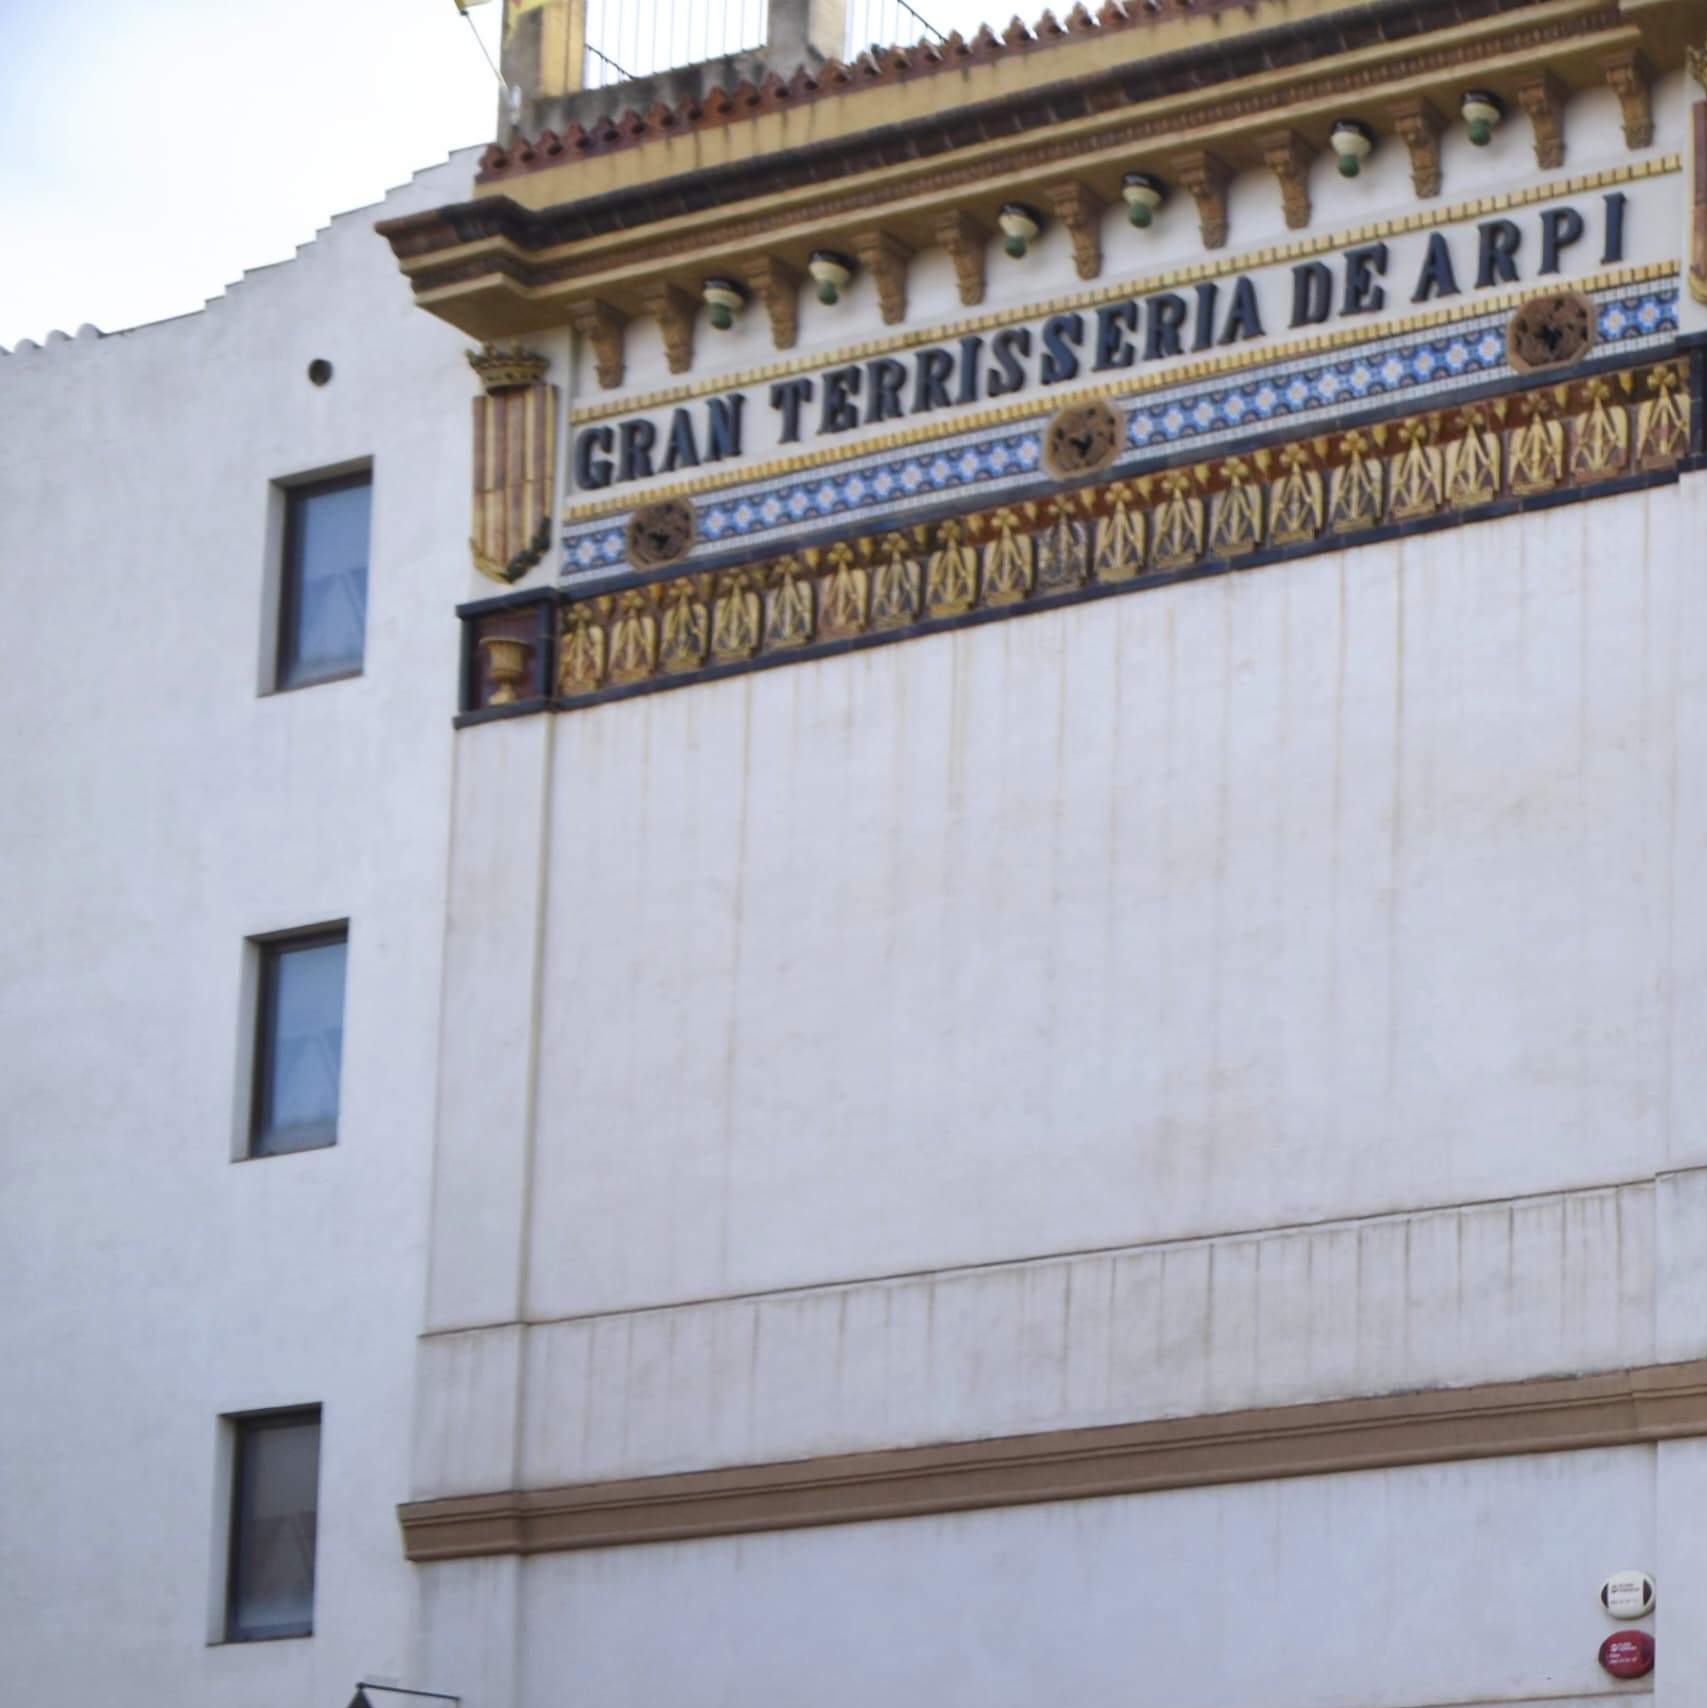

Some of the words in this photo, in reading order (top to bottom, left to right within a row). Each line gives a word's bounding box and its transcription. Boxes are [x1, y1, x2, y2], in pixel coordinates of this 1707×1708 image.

[574, 392, 747, 493] GRAN
[769, 274, 1265, 444] TERRISSERIA
[1290, 241, 1389, 328] DE
[1411, 192, 1627, 303] ARPI
